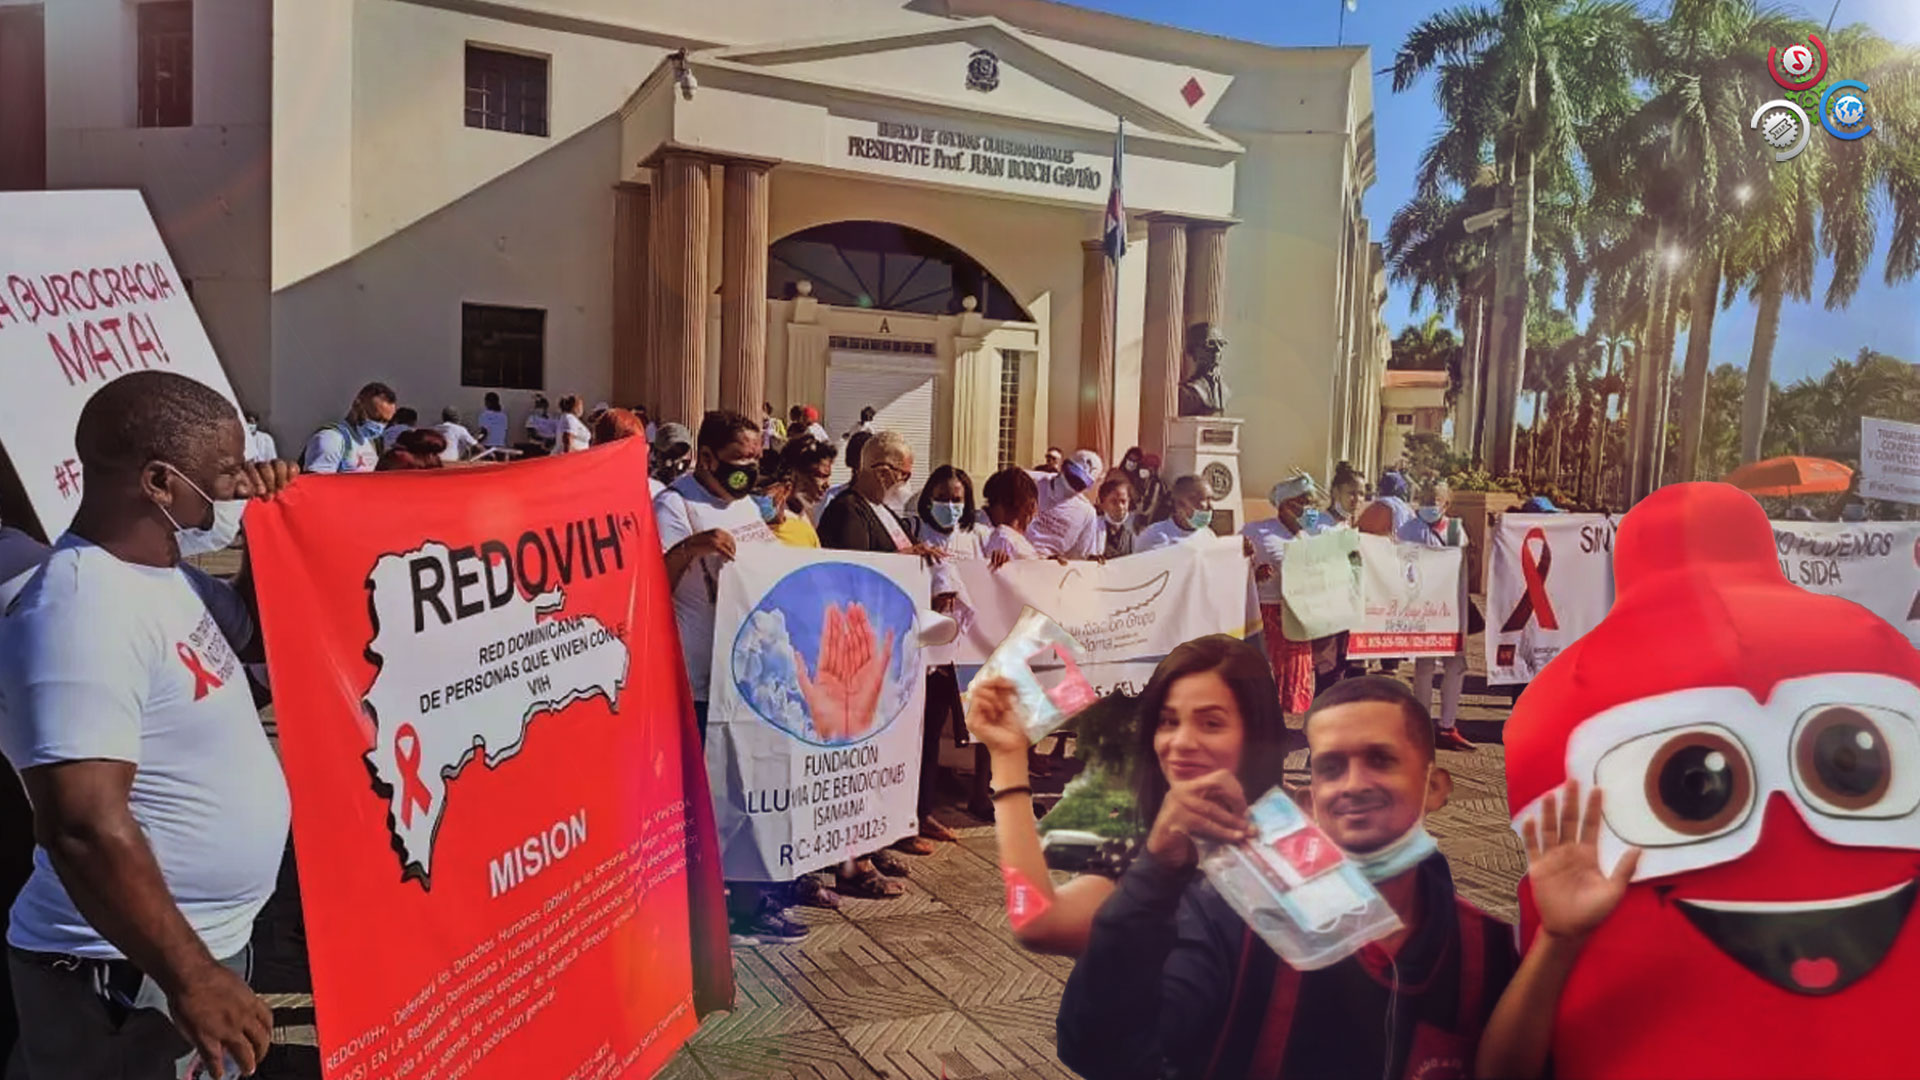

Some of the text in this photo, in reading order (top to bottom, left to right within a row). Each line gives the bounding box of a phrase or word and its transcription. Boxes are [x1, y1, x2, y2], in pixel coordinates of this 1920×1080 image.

[848, 136, 930, 167] PRESIDENTE
[933, 148, 966, 171] Prof.
[969, 153, 1005, 177] JUAN
[8, 262, 176, 324] BUROCRACIA
[879, 317, 890, 334] A
[47, 312, 170, 386] MATA!
[1799, 559, 1842, 586] SIDA
[478, 614, 585, 667] RED DOMINICANA
[419, 690, 441, 715] DE
[445, 659, 521, 704] PERSONAS
[522, 648, 550, 673] QUE
[551, 630, 589, 662] VIVEN
[590, 626, 615, 648] CON
[527, 674, 551, 698] VIH
[804, 742, 878, 777] FUNDACIÓN
[812, 779, 829, 803] DE
[833, 763, 906, 800] BENDICIONES
[488, 808, 589, 898] MISION
[371, 1047, 388, 1070] EN
[391, 1037, 405, 1056] LA
